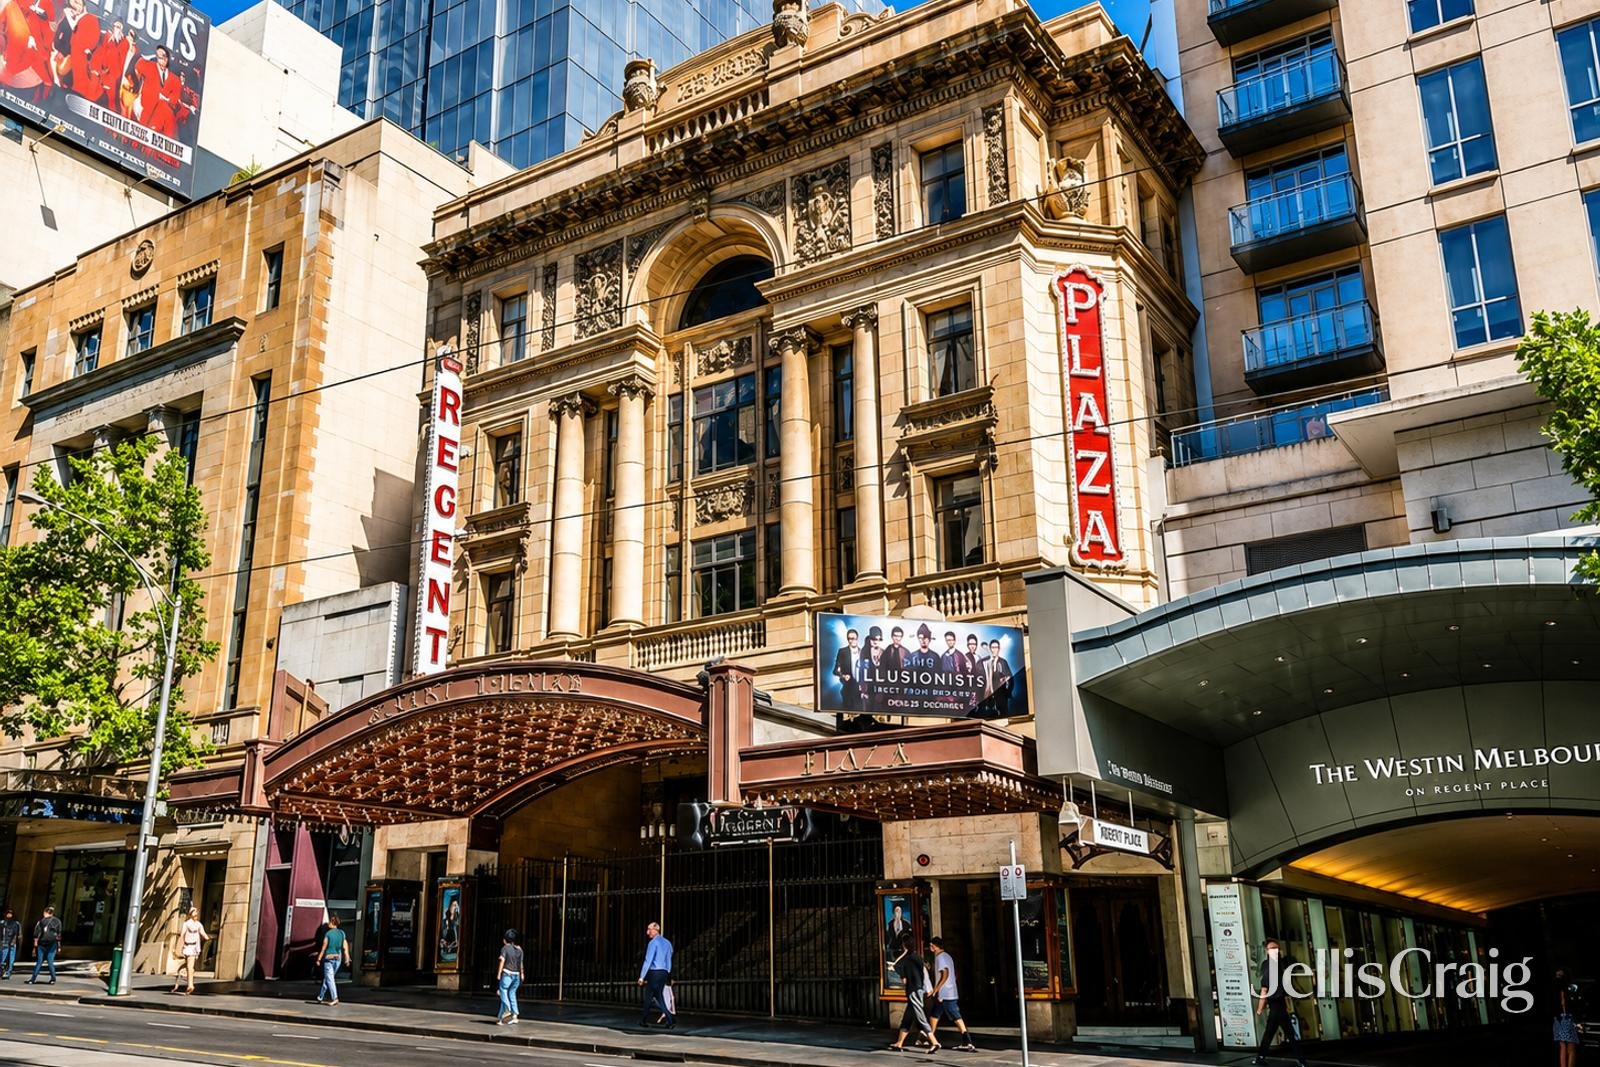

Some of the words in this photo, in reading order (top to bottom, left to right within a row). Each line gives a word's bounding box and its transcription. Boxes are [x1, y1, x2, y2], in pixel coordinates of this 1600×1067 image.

[127, 0, 198, 61] BOYS
[1062, 281, 1118, 555] PLAZA
[425, 385, 460, 665] REGENT
[856, 667, 985, 688] ILLUSIONISTS
[1309, 763, 1358, 785] THE
[1364, 754, 1464, 779] WESTIN
[1405, 787, 1425, 796] ON
[1435, 782, 1492, 794] REGENT
[1501, 779, 1549, 790] PLACE
